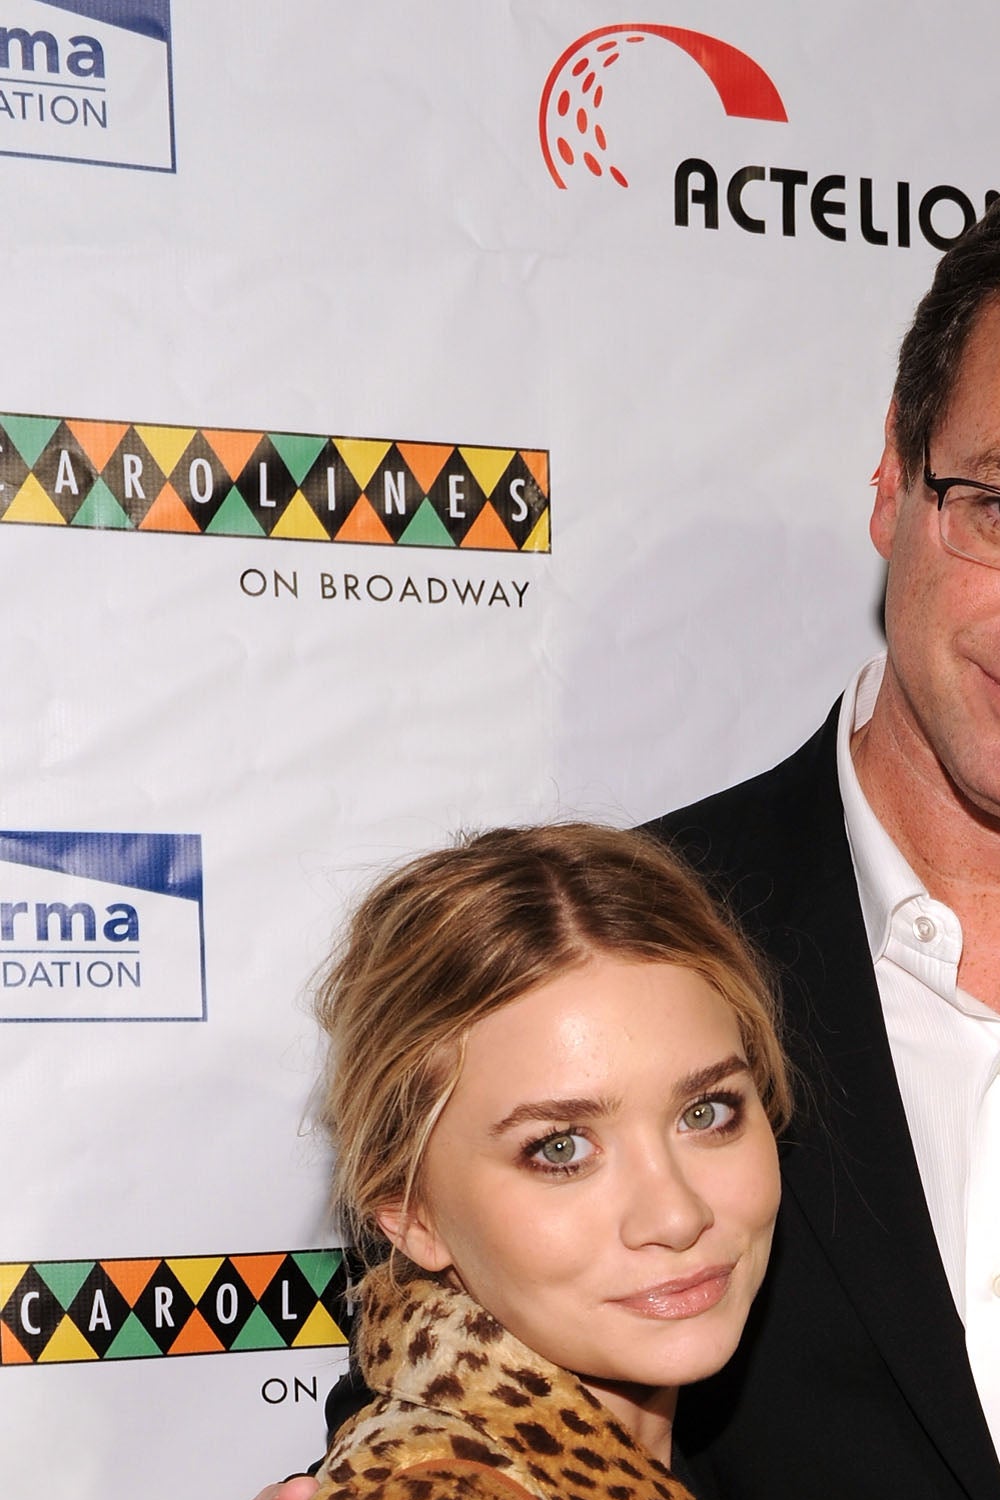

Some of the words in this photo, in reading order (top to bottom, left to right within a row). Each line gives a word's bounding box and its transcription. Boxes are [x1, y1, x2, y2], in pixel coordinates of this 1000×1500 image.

[0, 445, 526, 523] AROLINES
[240, 568, 298, 599] ON
[320, 572, 530, 608] BROADWAY
[0, 902, 140, 943] rma
[2, 960, 141, 988] DATION
[261, 1375, 318, 1404] ON
